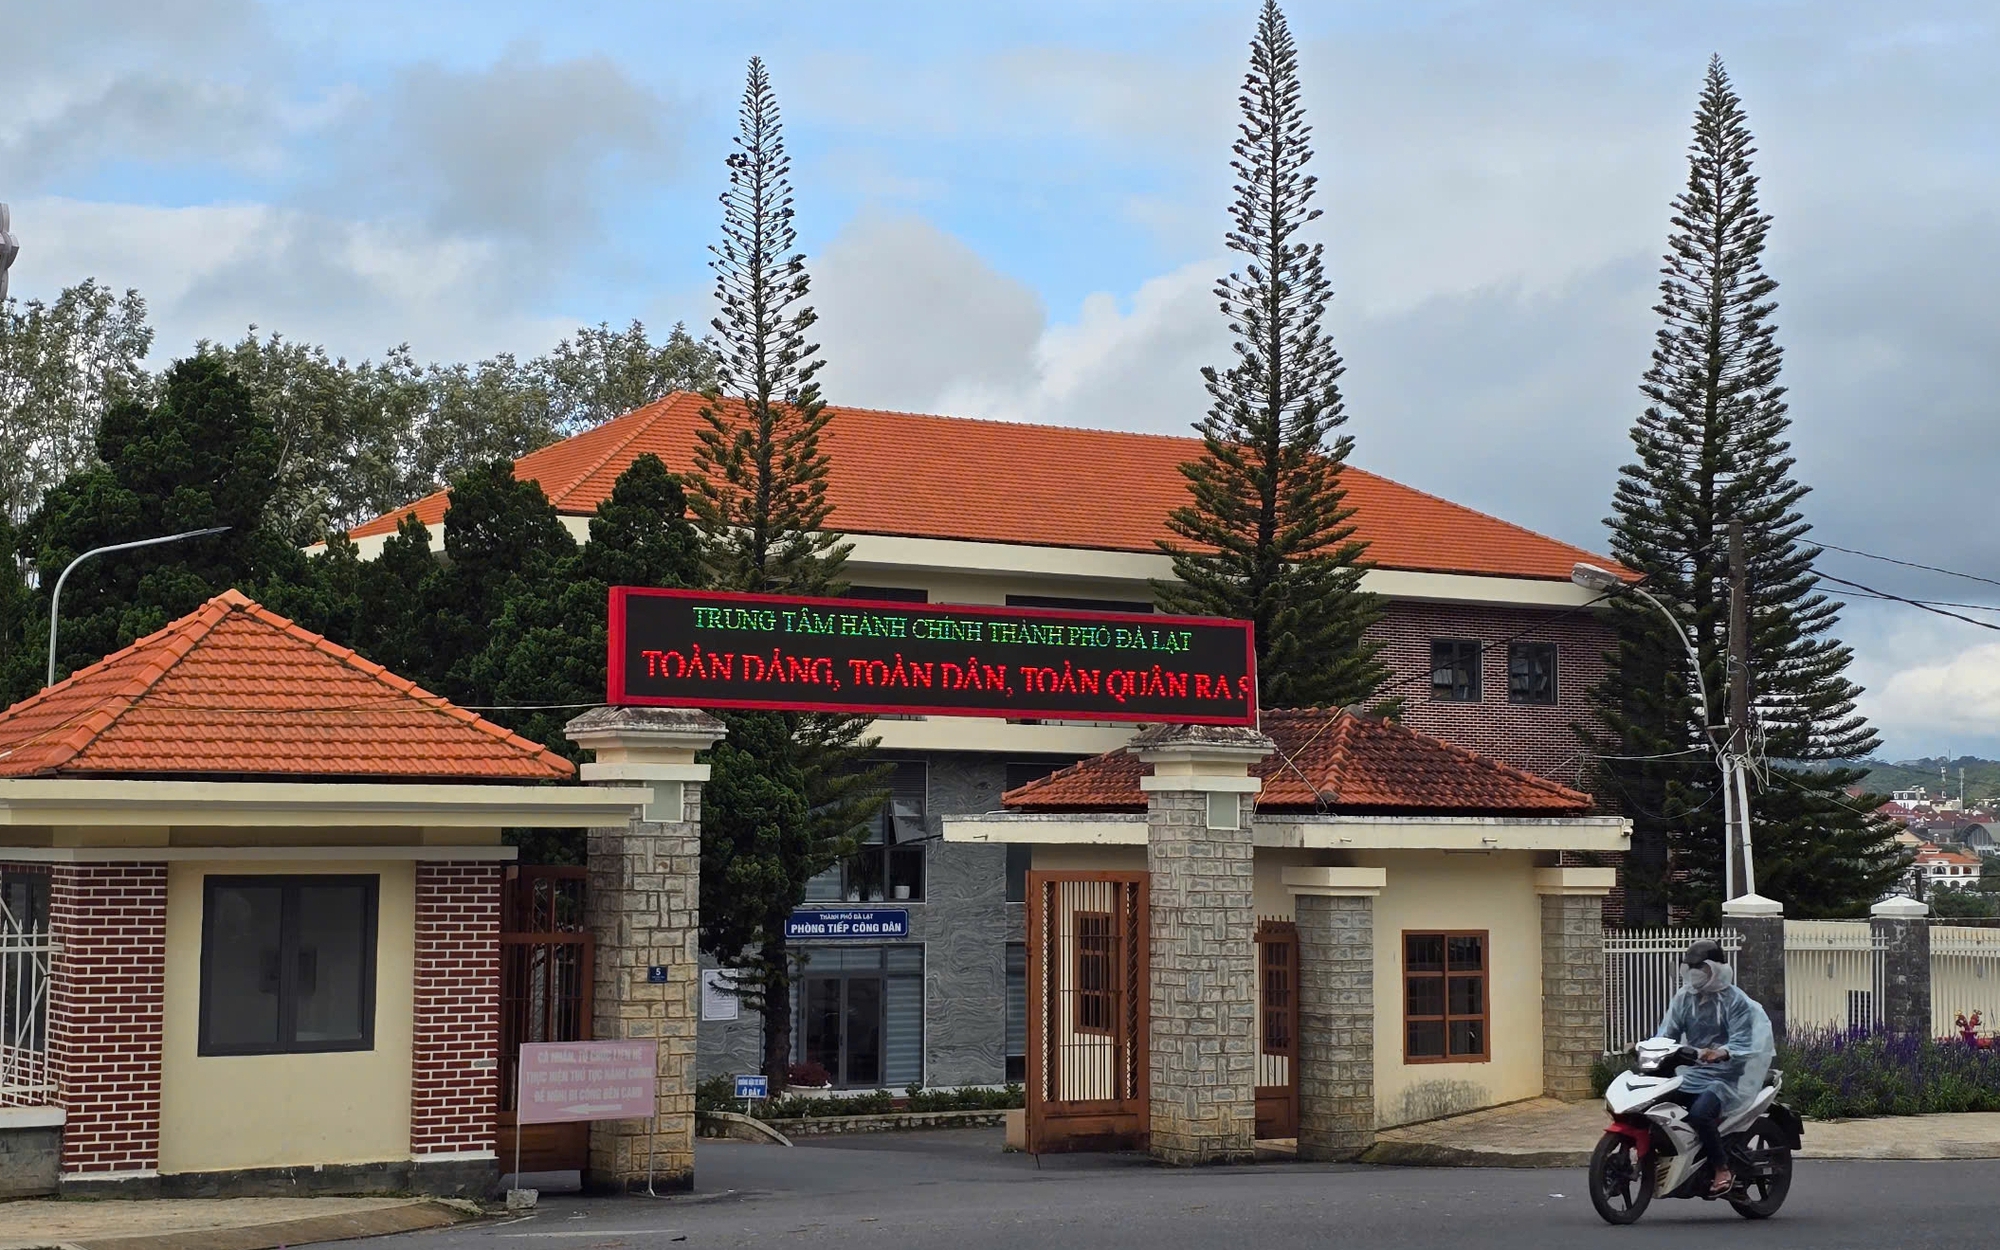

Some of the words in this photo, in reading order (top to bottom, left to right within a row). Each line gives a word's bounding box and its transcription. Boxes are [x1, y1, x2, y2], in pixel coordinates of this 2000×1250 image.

[692, 606, 777, 632] TRUNG
[782, 607, 835, 635] TÂM
[840, 611, 908, 638] HÀNH
[912, 615, 983, 641] CHÍNH
[988, 618, 1065, 646] THÀNH
[1115, 625, 1148, 649] ĐÀ
[1151, 631, 1192, 654] LẠT
[940, 656, 1014, 698] DÂN,
[1106, 664, 1188, 703] QUÂN
[1194, 673, 1232, 700] RA
[791, 921, 825, 934] PHÒNG
[827, 920, 849, 933] TIẾP
[852, 921, 879, 933] CÔNG
[882, 921, 901, 932] DÂN
[655, 967, 661, 976] 5
